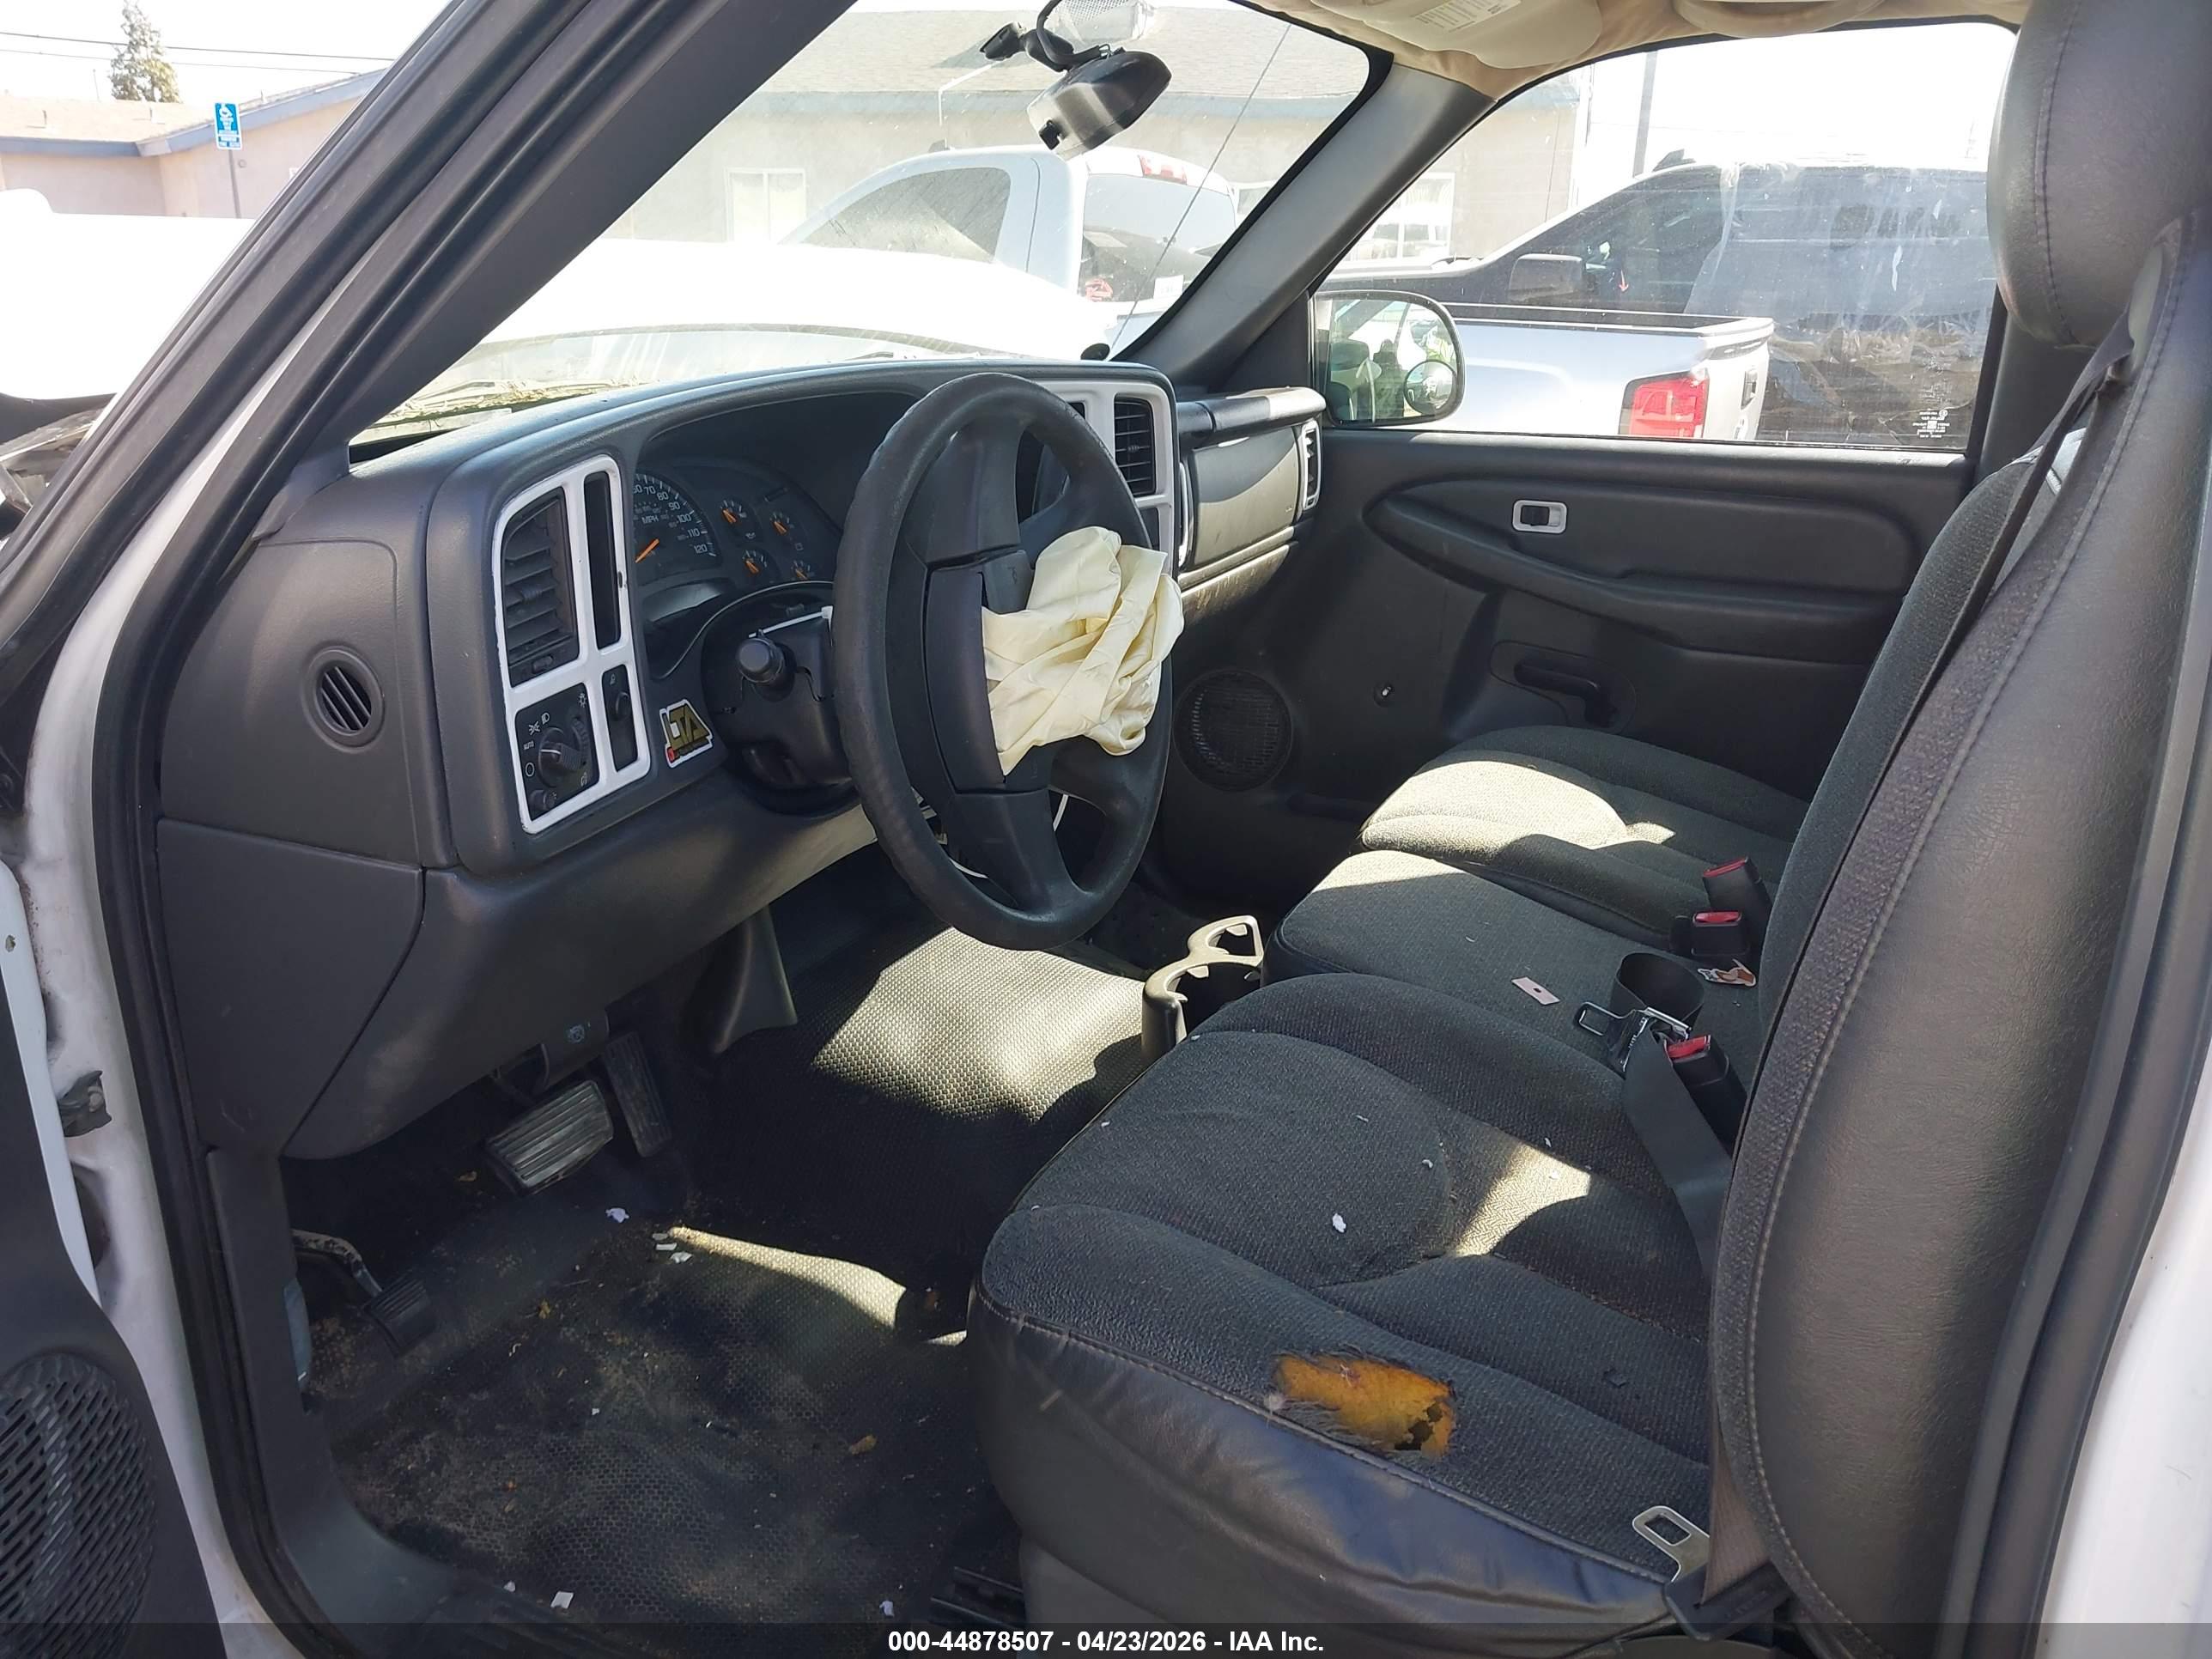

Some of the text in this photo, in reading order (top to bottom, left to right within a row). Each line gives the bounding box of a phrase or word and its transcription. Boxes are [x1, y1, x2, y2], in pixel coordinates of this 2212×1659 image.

[644, 486, 655, 495] 70
[657, 491, 669, 501] 80
[668, 501, 680, 510] 90
[641, 515, 659, 524] MPH
[678, 514, 691, 523] 100
[688, 528, 700, 537] 110
[694, 544, 707, 554] 120
[524, 740, 535, 750] AUTO
